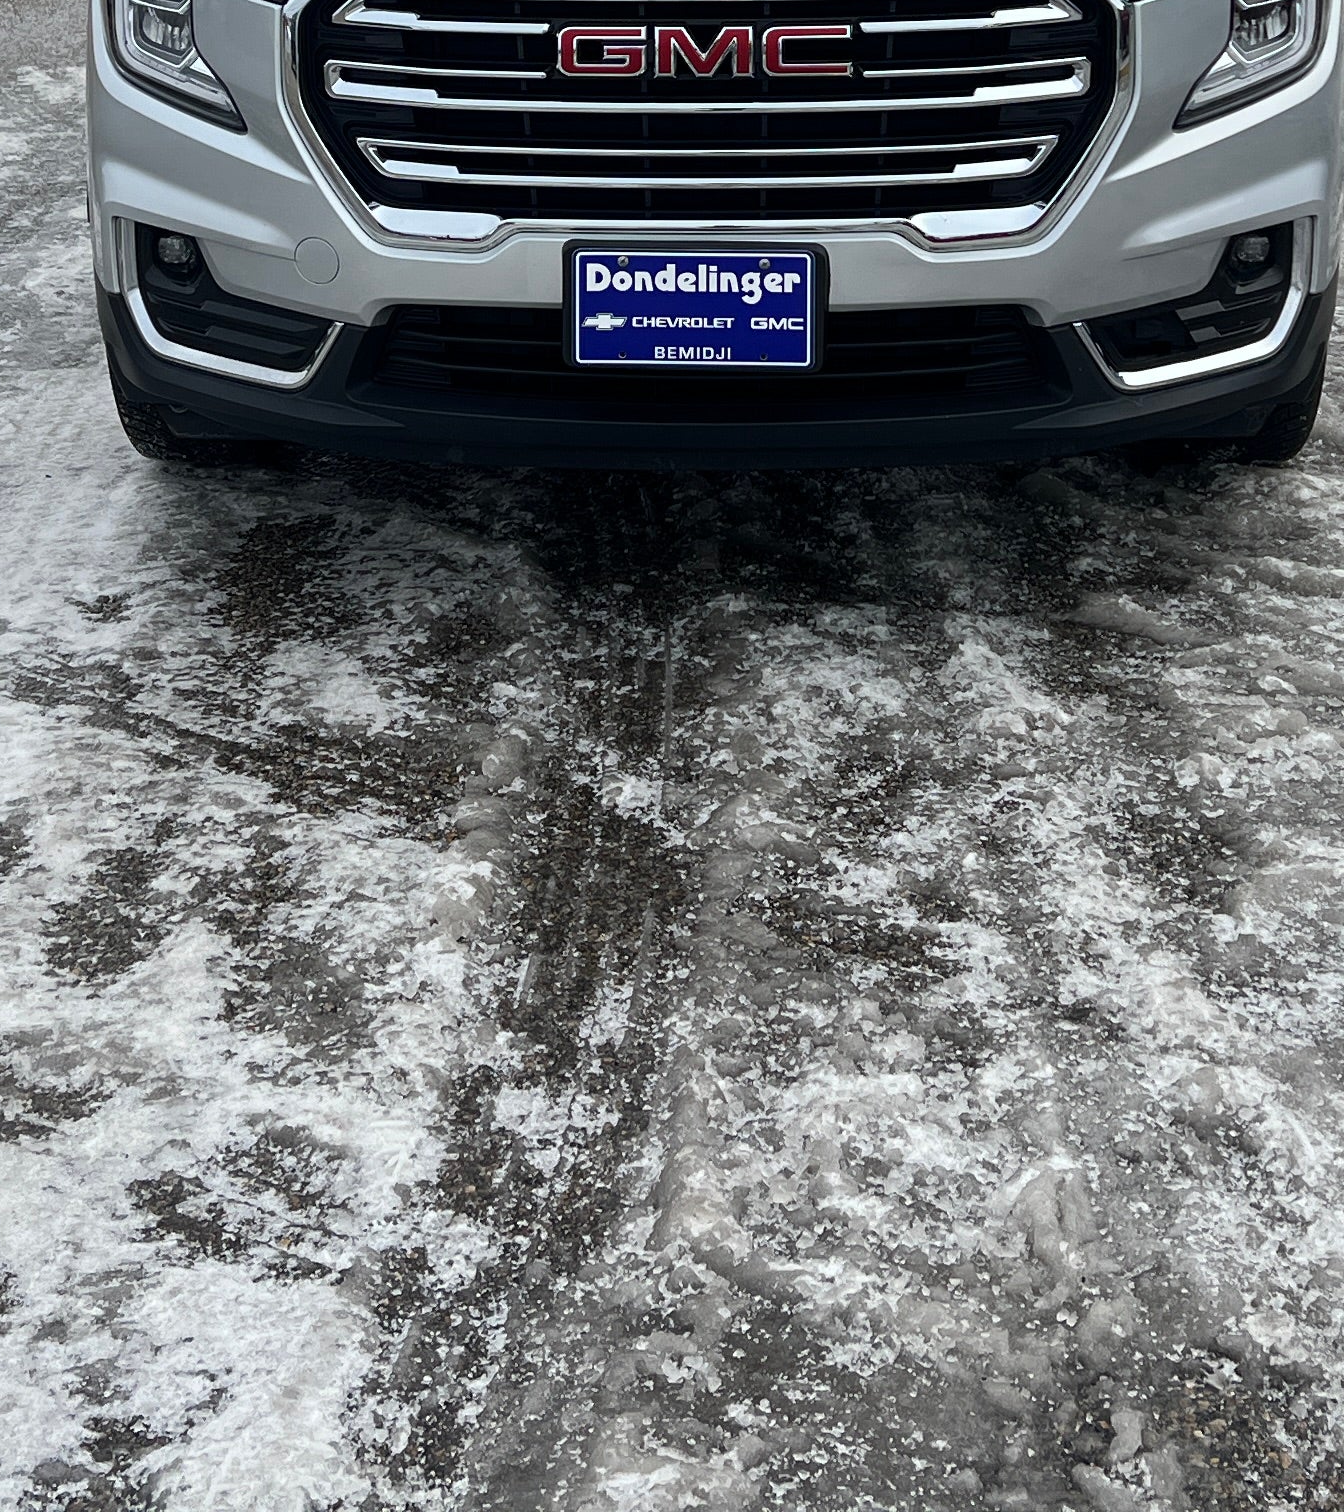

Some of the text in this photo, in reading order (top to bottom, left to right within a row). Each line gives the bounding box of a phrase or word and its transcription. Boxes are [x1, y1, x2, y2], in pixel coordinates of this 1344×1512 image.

[558, 25, 853, 78] GMC
[586, 262, 801, 305] Dondelinger
[632, 316, 805, 331] CHEVROLET GMC
[654, 346, 732, 360] BEMIDJI
